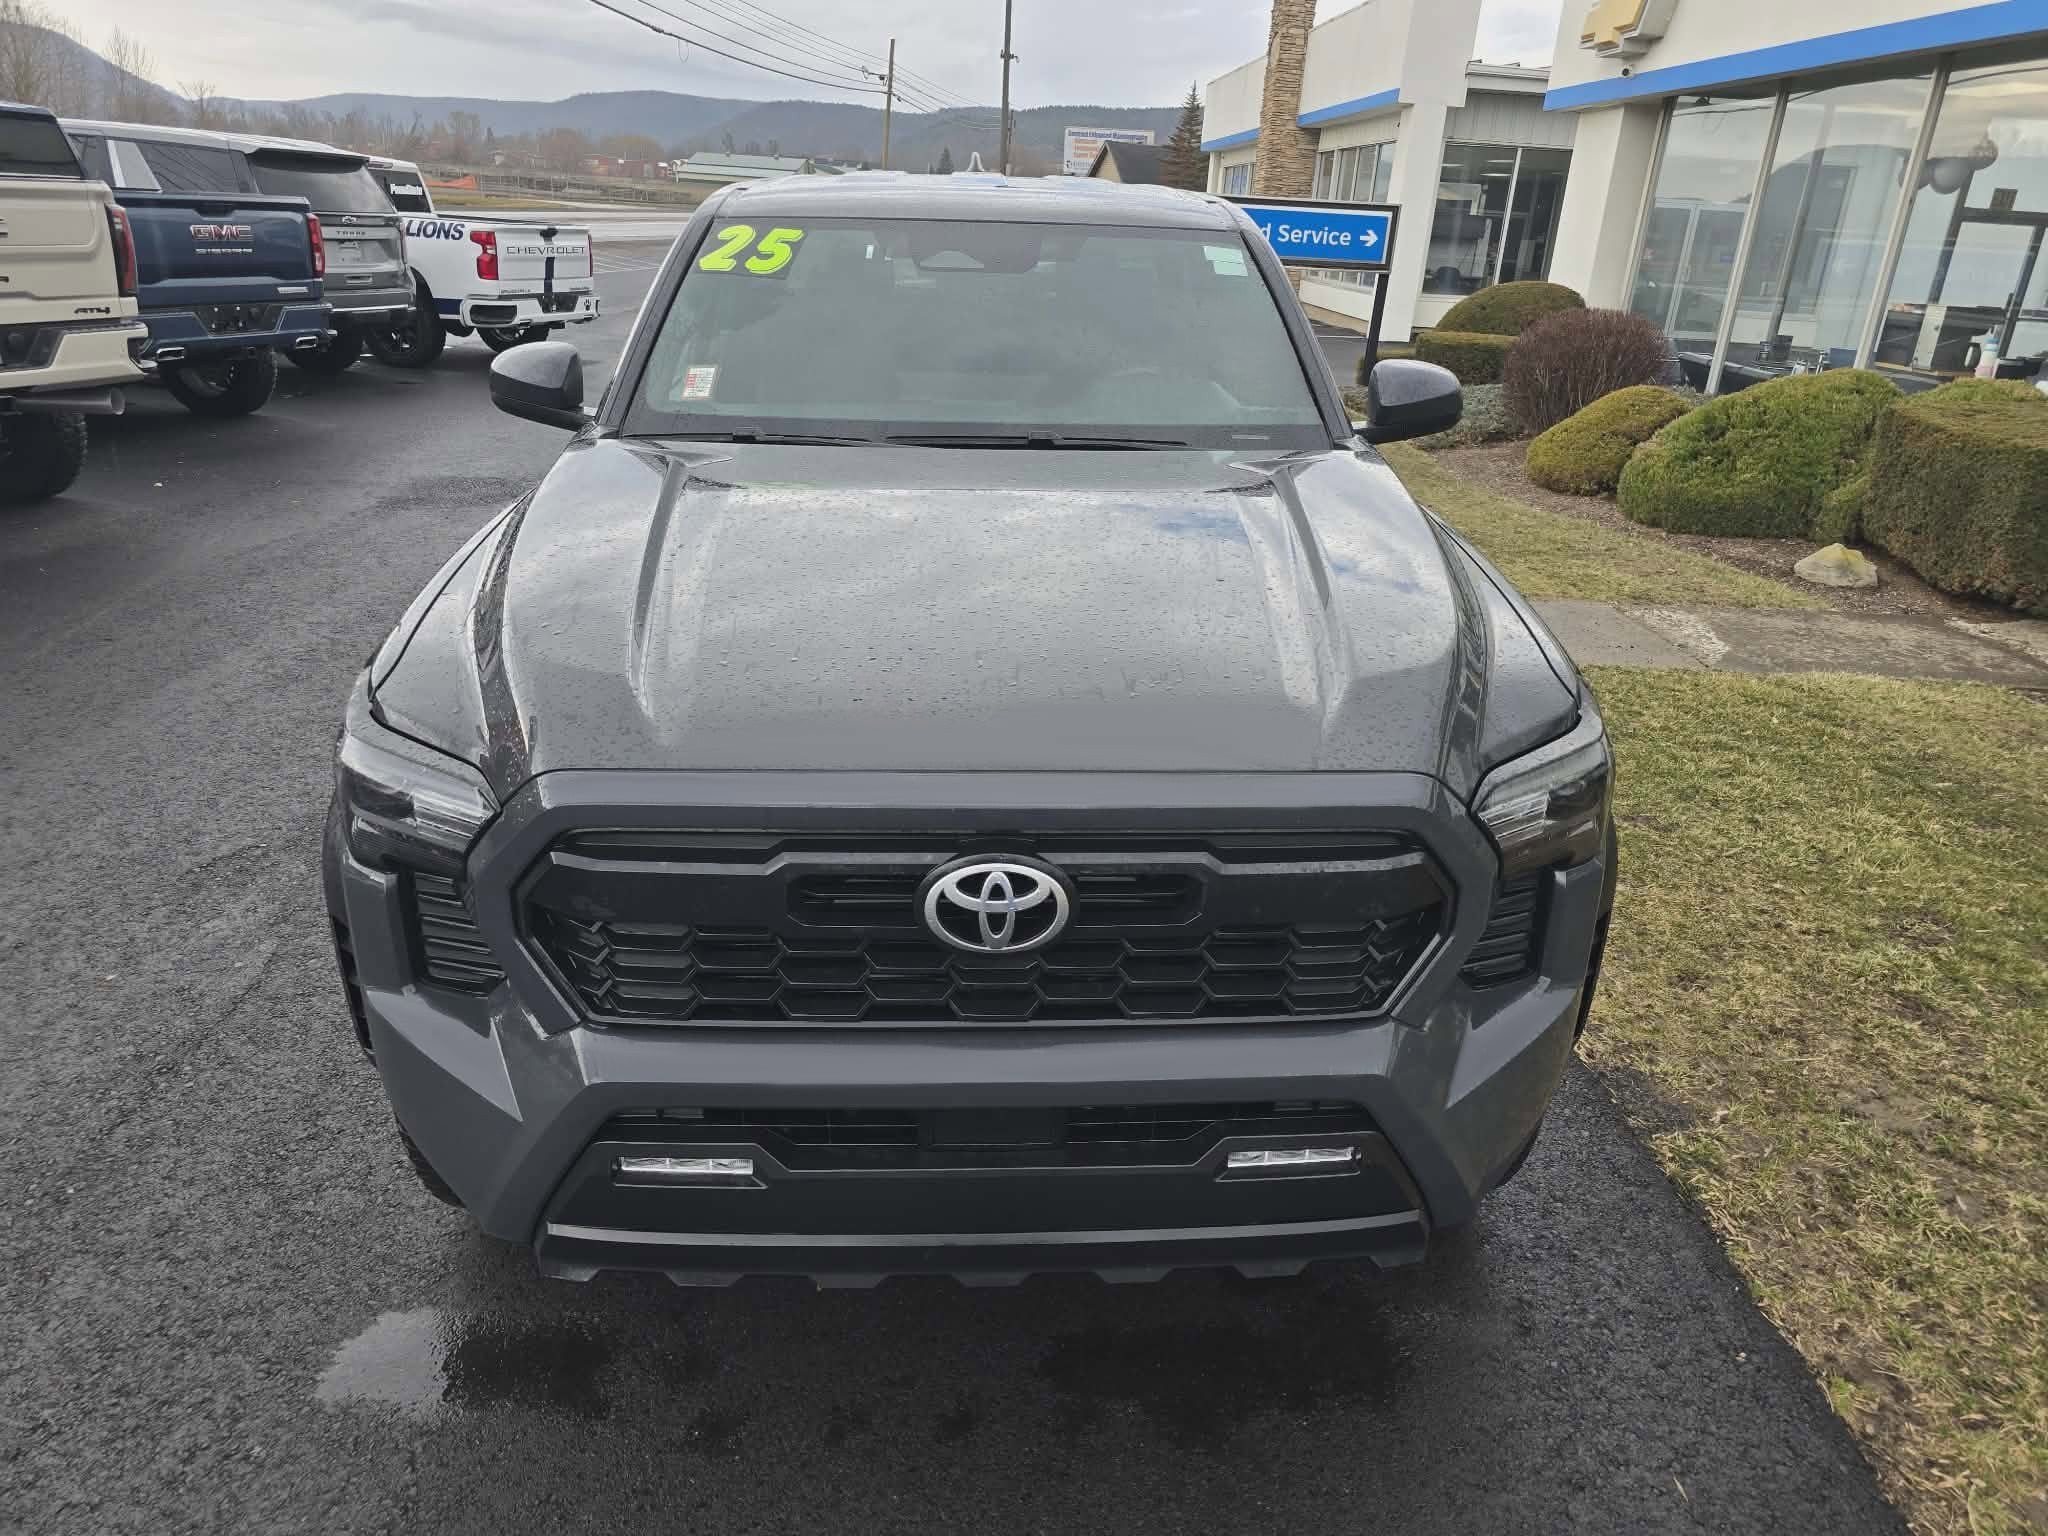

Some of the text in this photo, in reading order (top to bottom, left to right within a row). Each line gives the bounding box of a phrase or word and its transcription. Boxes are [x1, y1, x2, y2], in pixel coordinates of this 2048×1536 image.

[190, 224, 254, 240] GMC
[405, 220, 465, 241] LIONS
[1277, 224, 1351, 246] Service
[506, 246, 585, 255] CHEVROLET
[699, 224, 804, 274] 25
